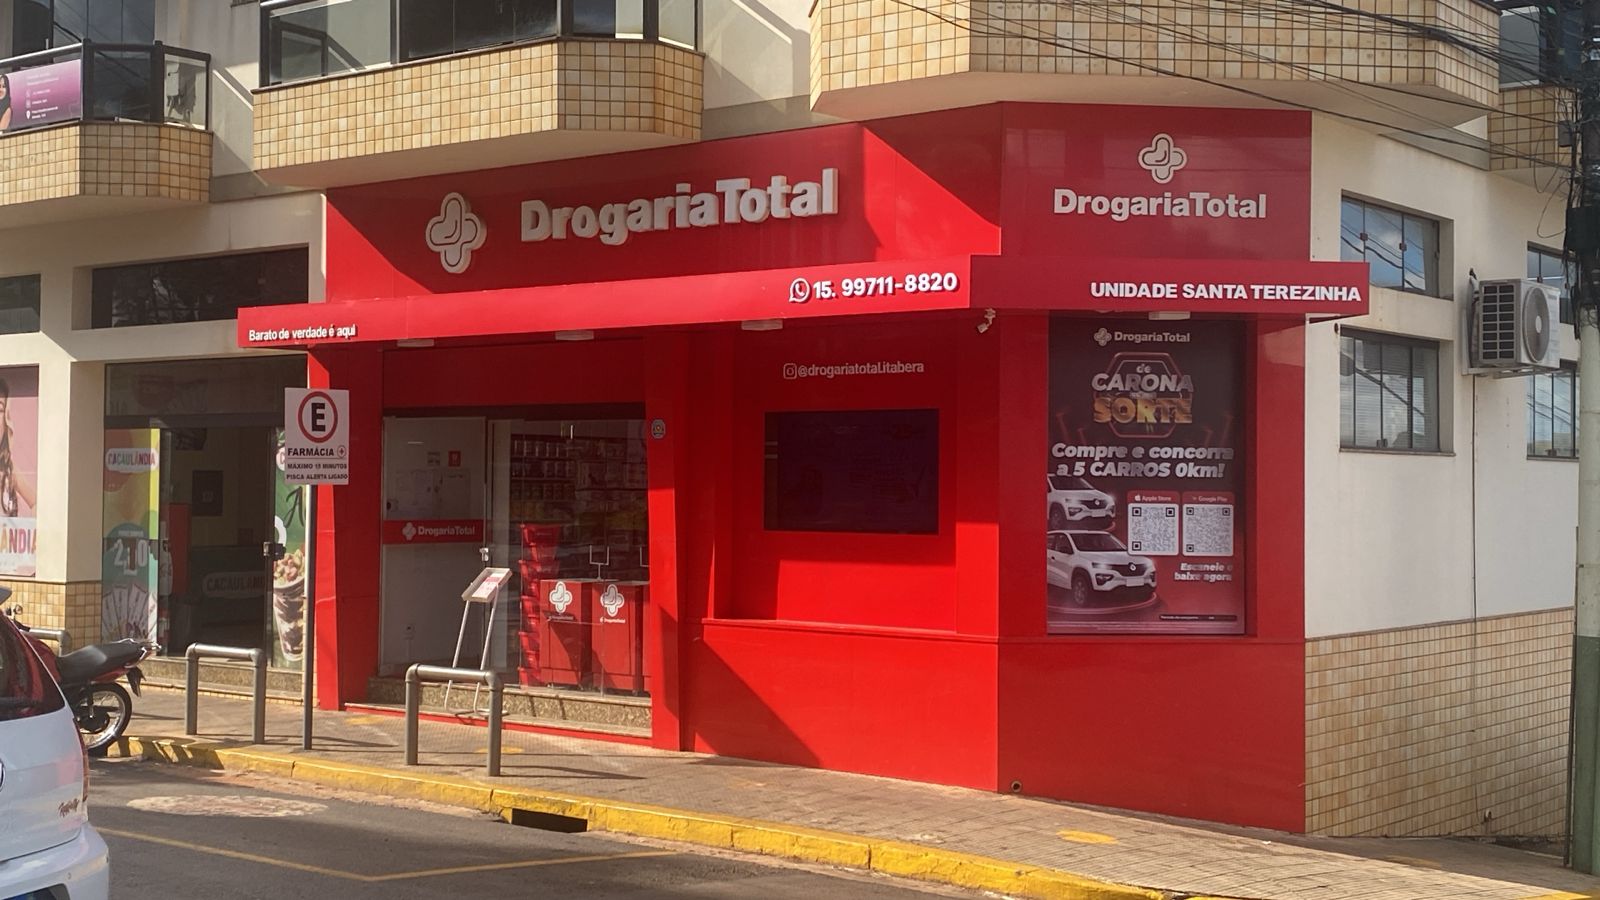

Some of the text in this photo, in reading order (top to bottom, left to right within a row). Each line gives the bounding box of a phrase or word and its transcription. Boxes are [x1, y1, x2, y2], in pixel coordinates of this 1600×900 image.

[521, 168, 838, 246] DrogariaTotal
[1054, 188, 1267, 222] DrogariaTotal
[813, 272, 958, 299] 15. 99711-8820
[1090, 282, 1362, 302] UNIDADE SANTA TEREZINHA
[248, 324, 357, 341] Barato de verdade é aqui
[1114, 331, 1190, 343] DrogariaTotal
[1136, 363, 1152, 373] de
[1091, 373, 1194, 392] CARONA
[311, 402, 326, 432] E
[1093, 396, 1193, 424] SORTE
[287, 446, 335, 457] FARMÁCIA
[1051, 442, 1234, 461] Compre e concorra
[1056, 461, 1226, 478] a 5 CARROS 0km!
[417, 525, 476, 537] DrogariaTotal
